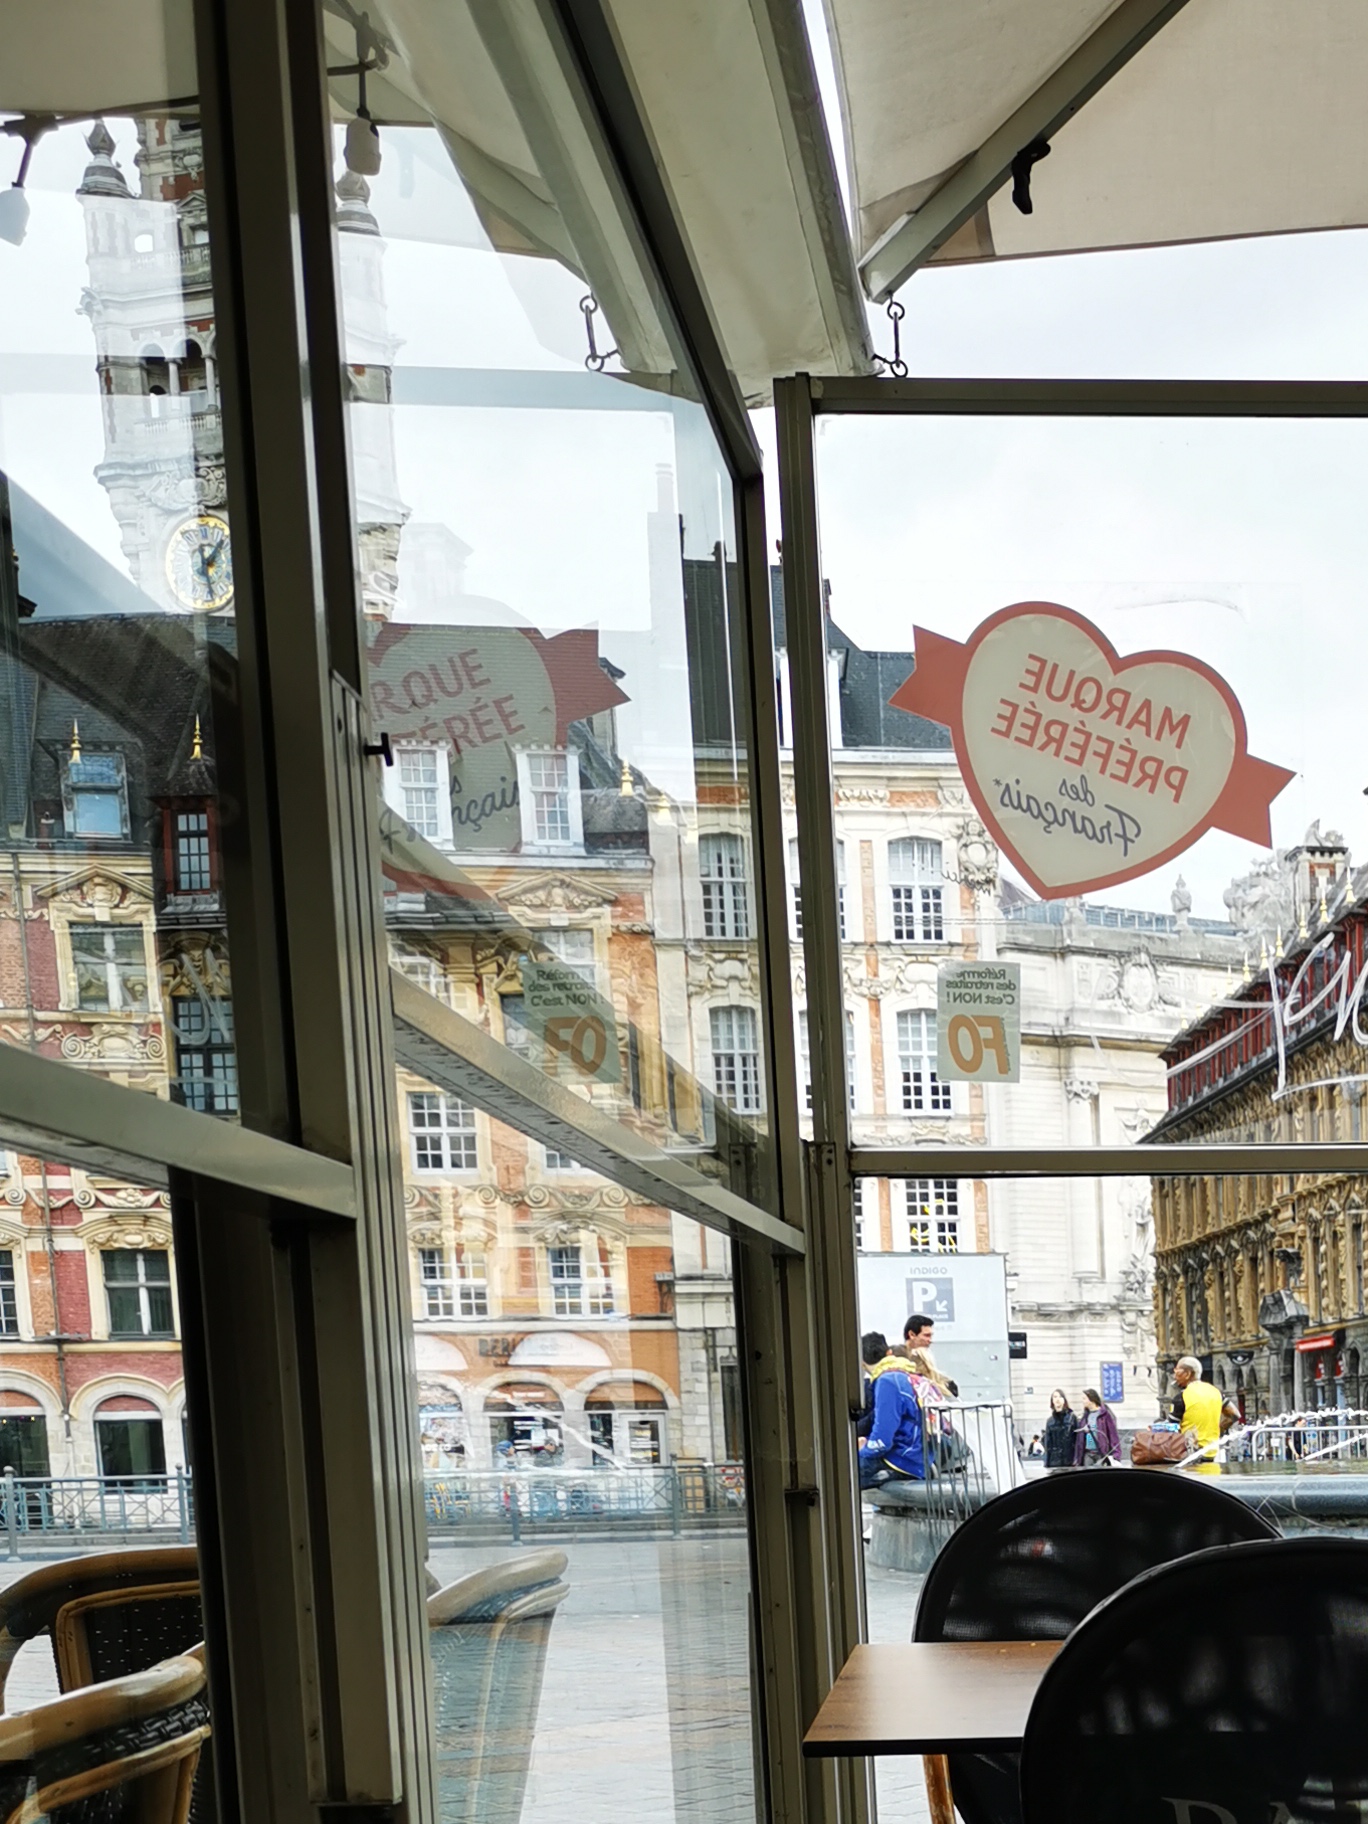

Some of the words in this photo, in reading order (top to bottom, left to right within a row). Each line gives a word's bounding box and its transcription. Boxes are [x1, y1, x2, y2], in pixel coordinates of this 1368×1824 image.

[544, 1015, 608, 1077] FO
[909, 1266, 948, 1275] INDIGO
[912, 1280, 937, 1312] P
